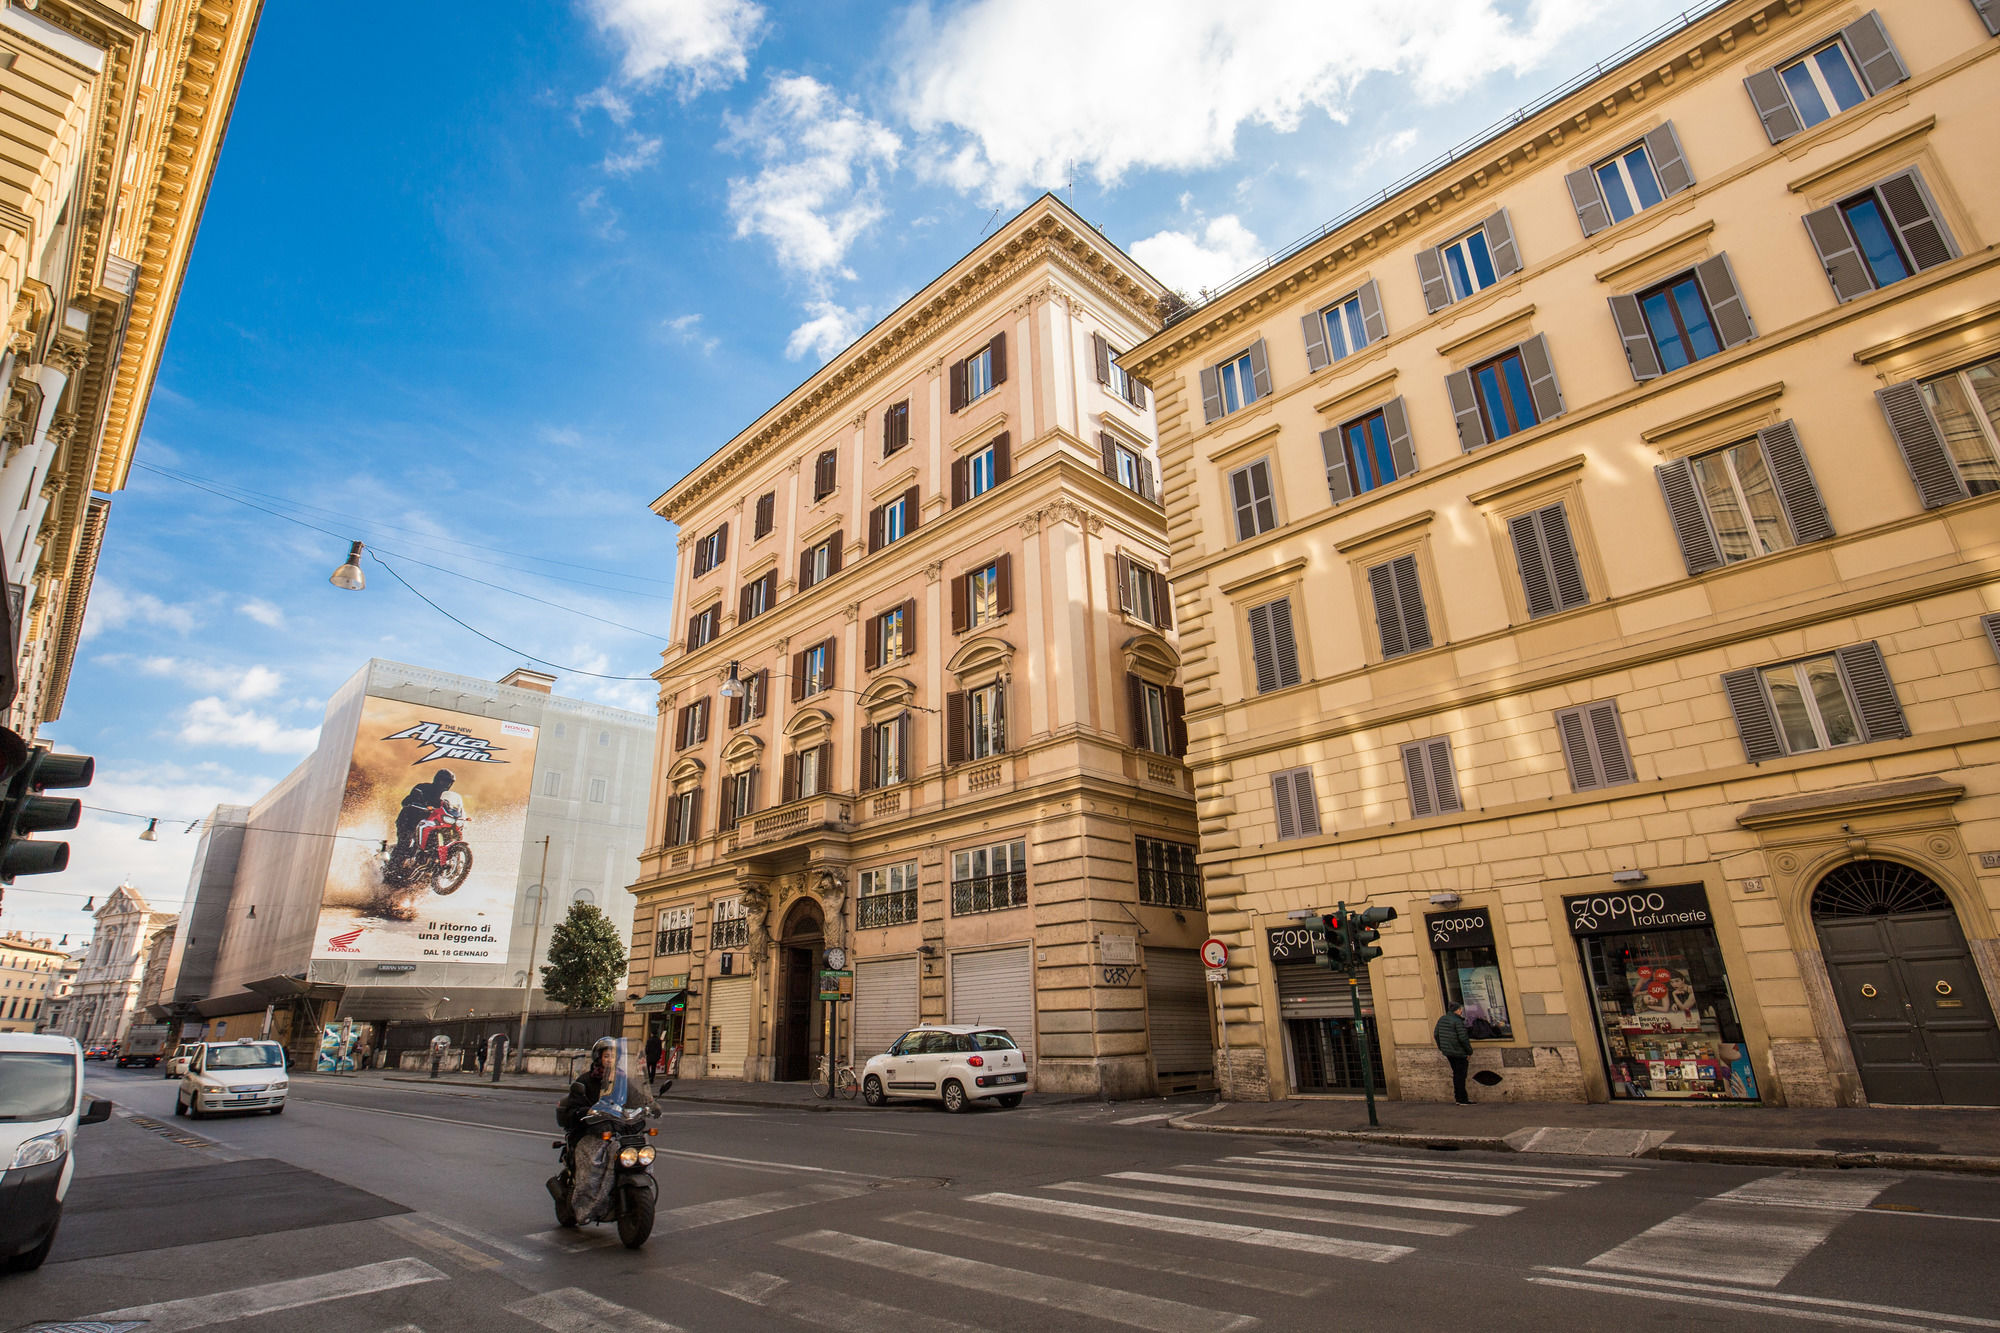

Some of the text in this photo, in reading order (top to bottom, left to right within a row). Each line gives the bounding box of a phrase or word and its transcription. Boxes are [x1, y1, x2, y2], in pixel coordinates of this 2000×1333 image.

[380, 720, 508, 750] Africa
[504, 724, 531, 733] HONDA
[411, 743, 511, 766] Twin
[1983, 855, 2000, 865] 19
[1570, 892, 1665, 930] Zoppo
[428, 921, 492, 934] Il ritorno di
[1431, 916, 1484, 943] Zoppo
[417, 932, 498, 945] una leggenda.
[1271, 929, 1326, 956] Zopp
[441, 949, 451, 957] 18
[453, 950, 489, 958] GENNAIO
[723, 953, 731, 967] T
